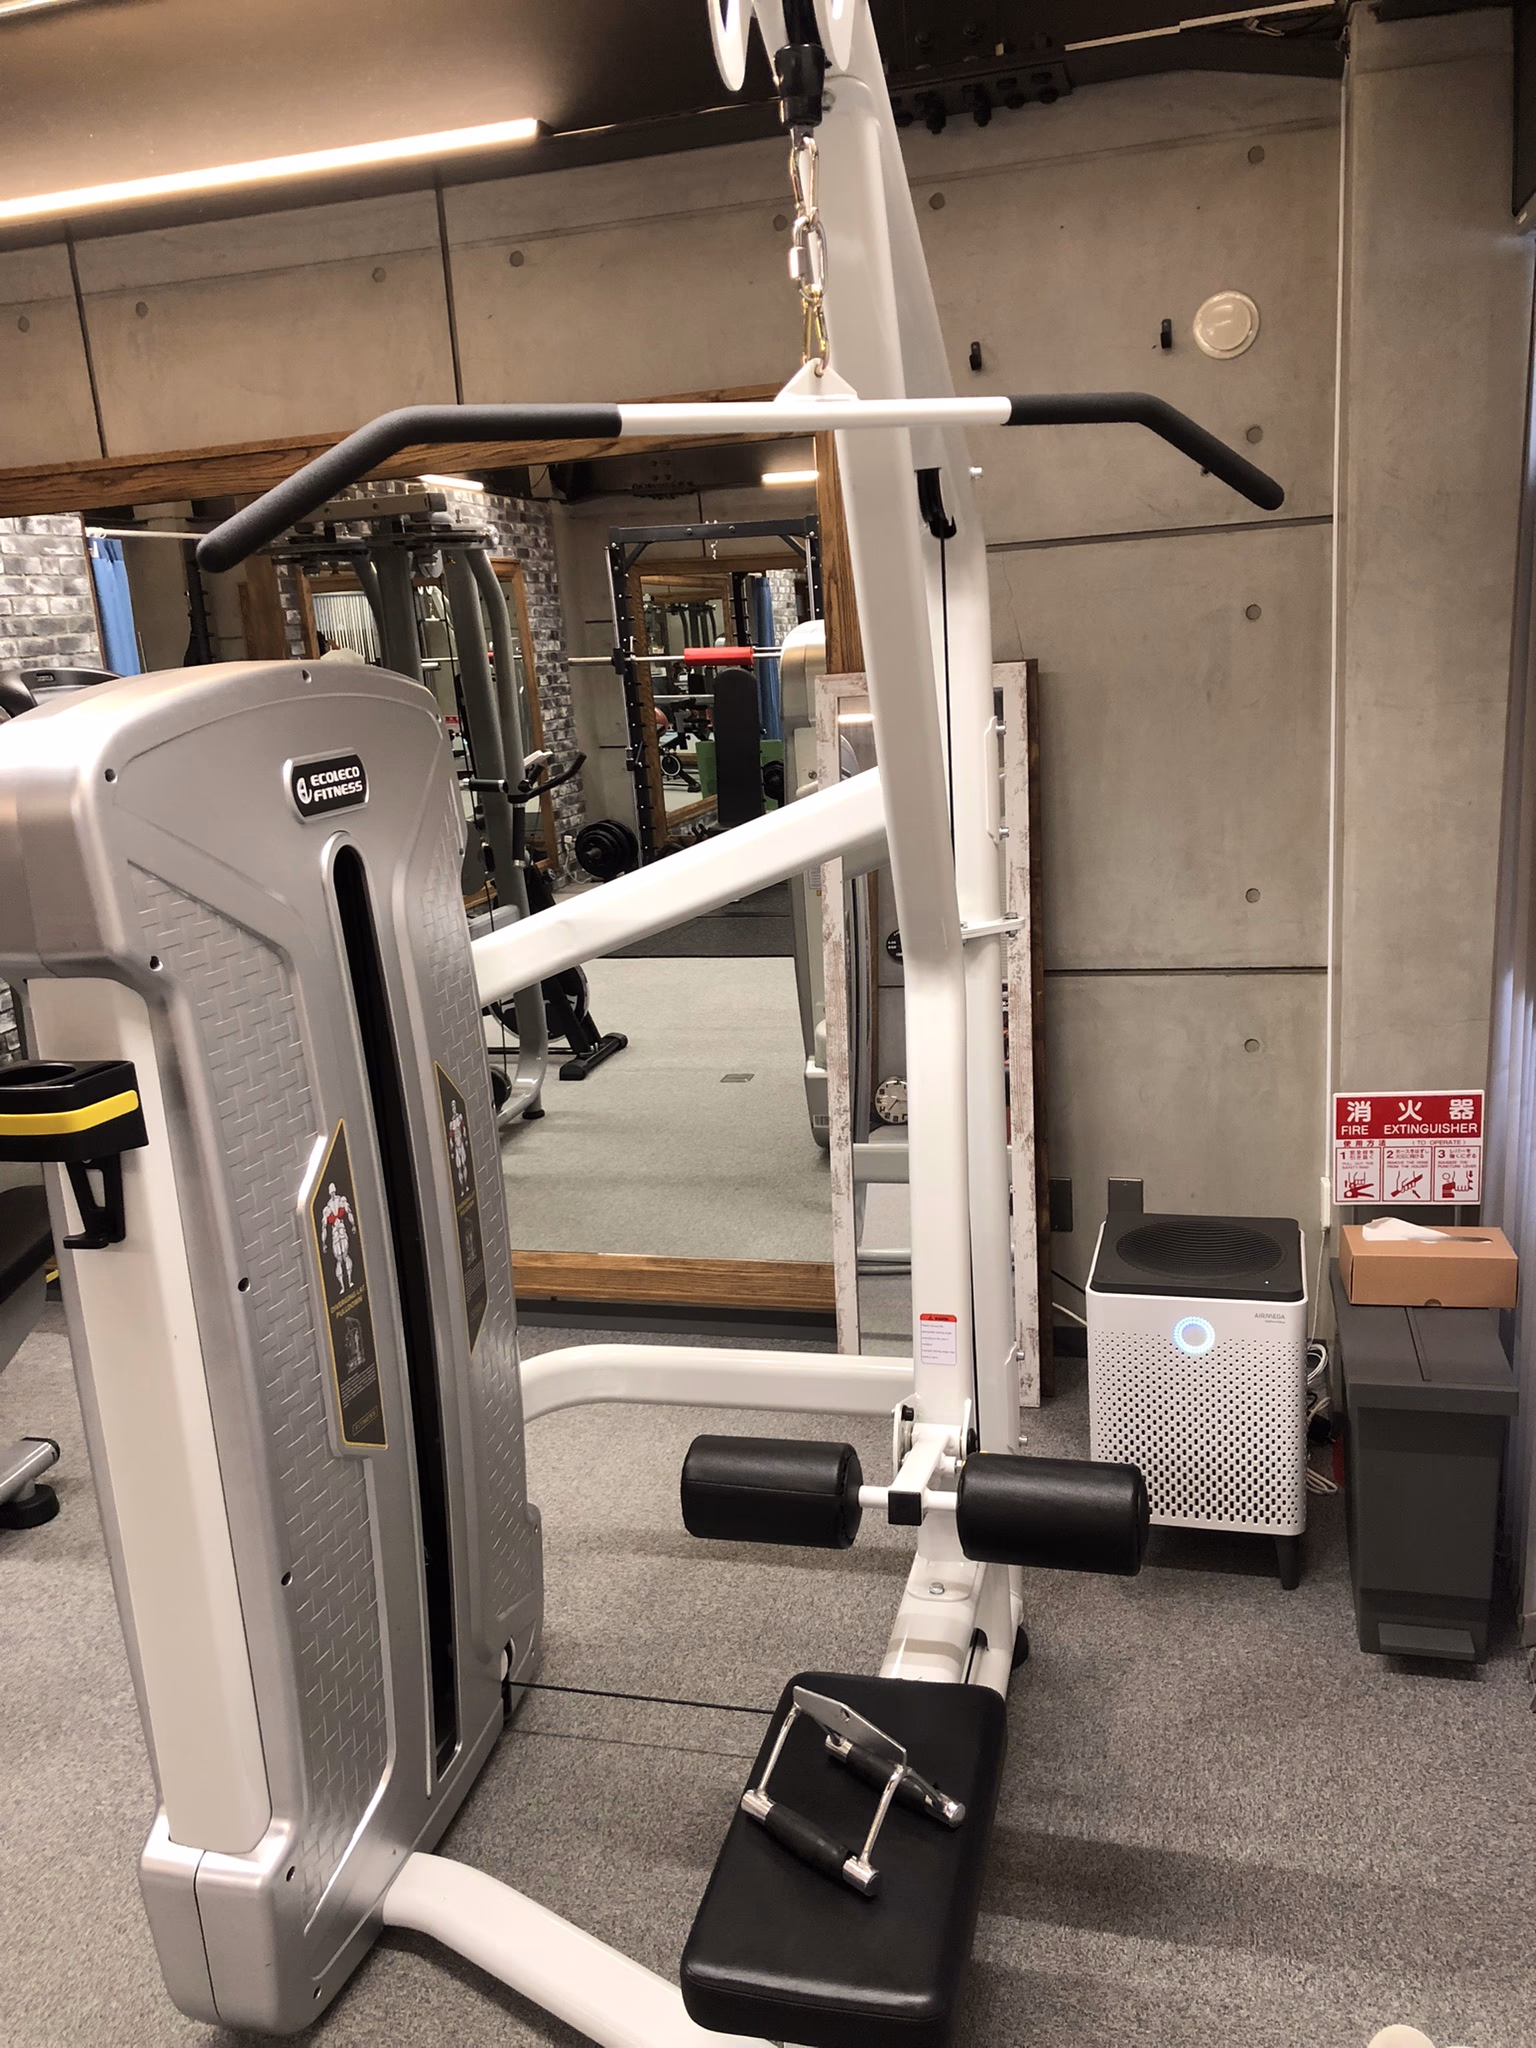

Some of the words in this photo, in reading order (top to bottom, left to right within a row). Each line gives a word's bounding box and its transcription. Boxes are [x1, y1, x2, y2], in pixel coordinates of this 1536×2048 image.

[314, 780, 363, 802] FITNESS
[1346, 1098, 1475, 1123] 消火器
[1341, 1125, 1369, 1136] FIRE
[1383, 1122, 1478, 1135] EXTINGUISHER
[1340, 1151, 1346, 1160] 1
[1386, 1150, 1394, 1159] 2
[1437, 1149, 1446, 1159] 3
